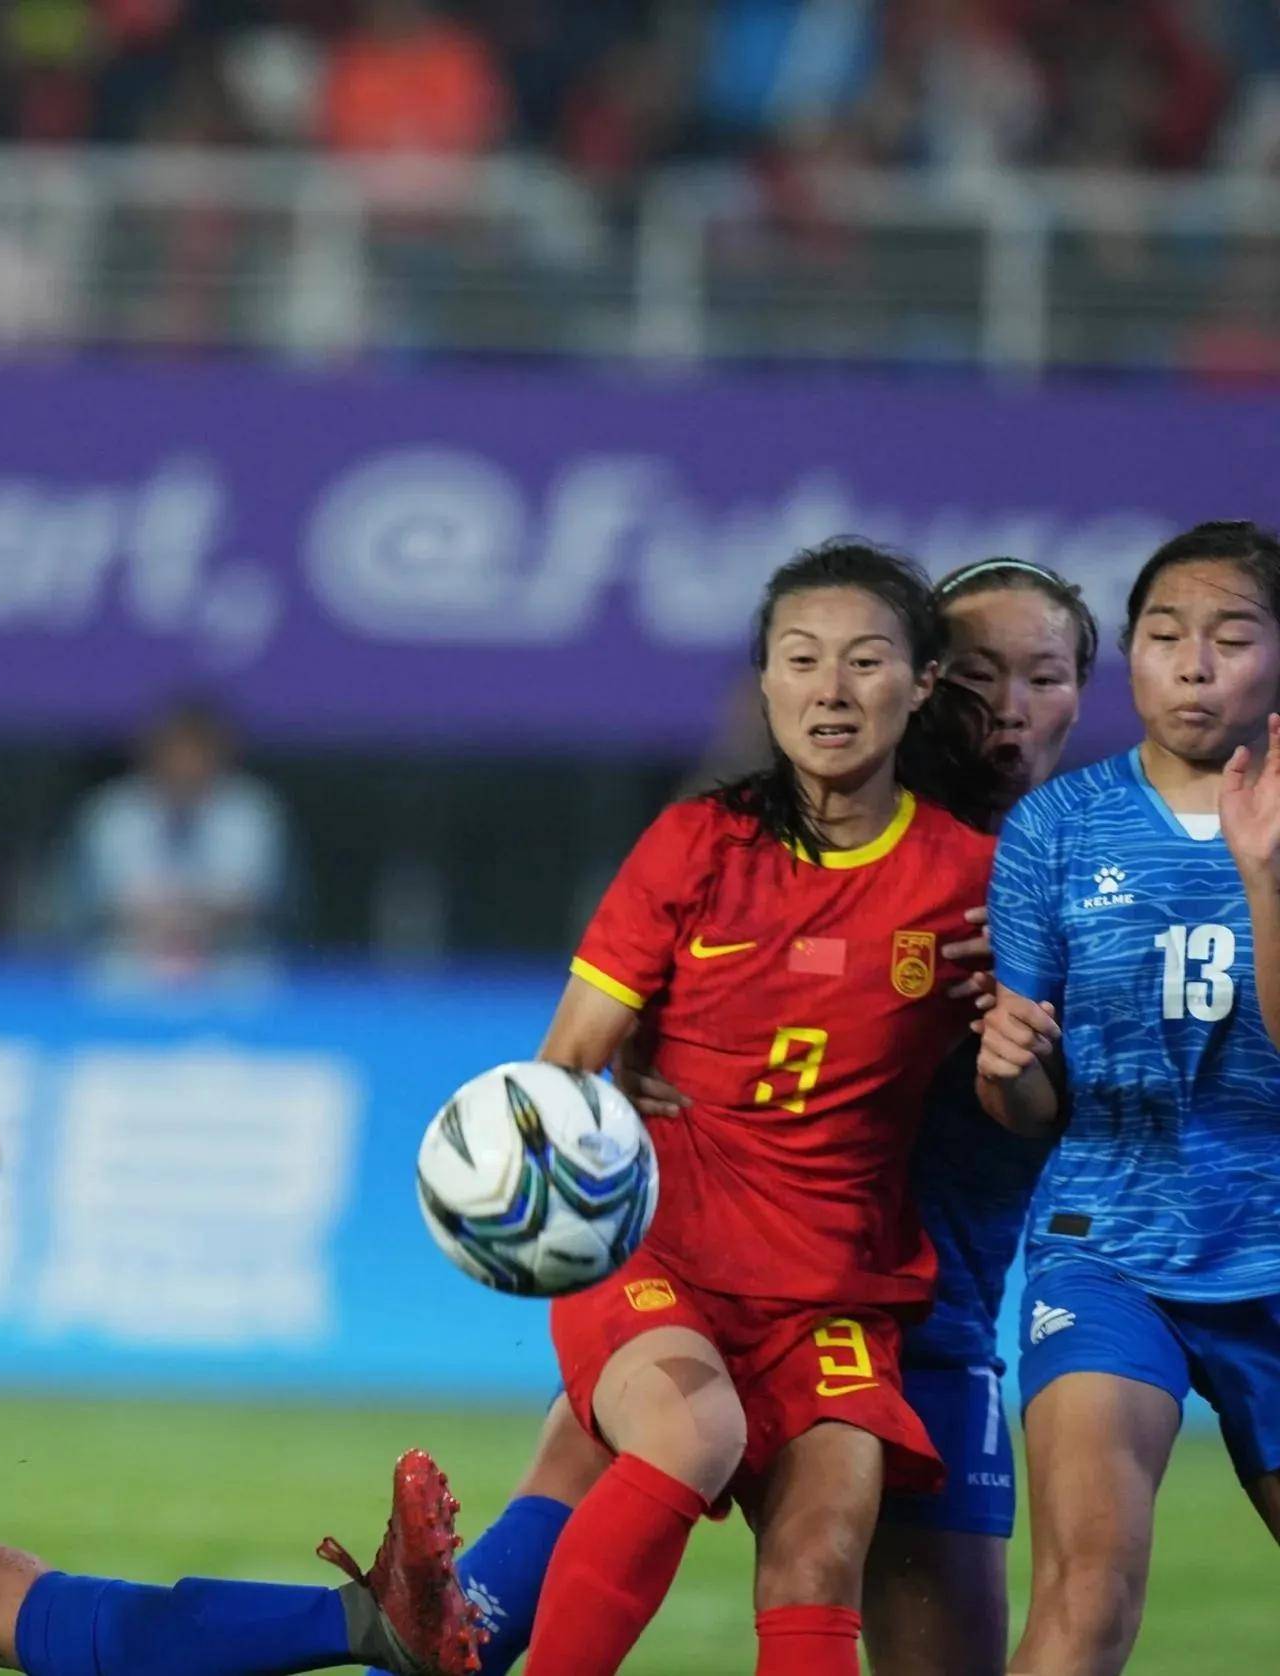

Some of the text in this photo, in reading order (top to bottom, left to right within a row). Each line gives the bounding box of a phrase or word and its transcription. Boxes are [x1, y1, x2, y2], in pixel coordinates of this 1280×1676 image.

[1083, 894, 1135, 909] KELME
[1154, 923, 1236, 1022] 13
[755, 1027, 828, 1114] 9
[814, 1317, 873, 1378] 9
